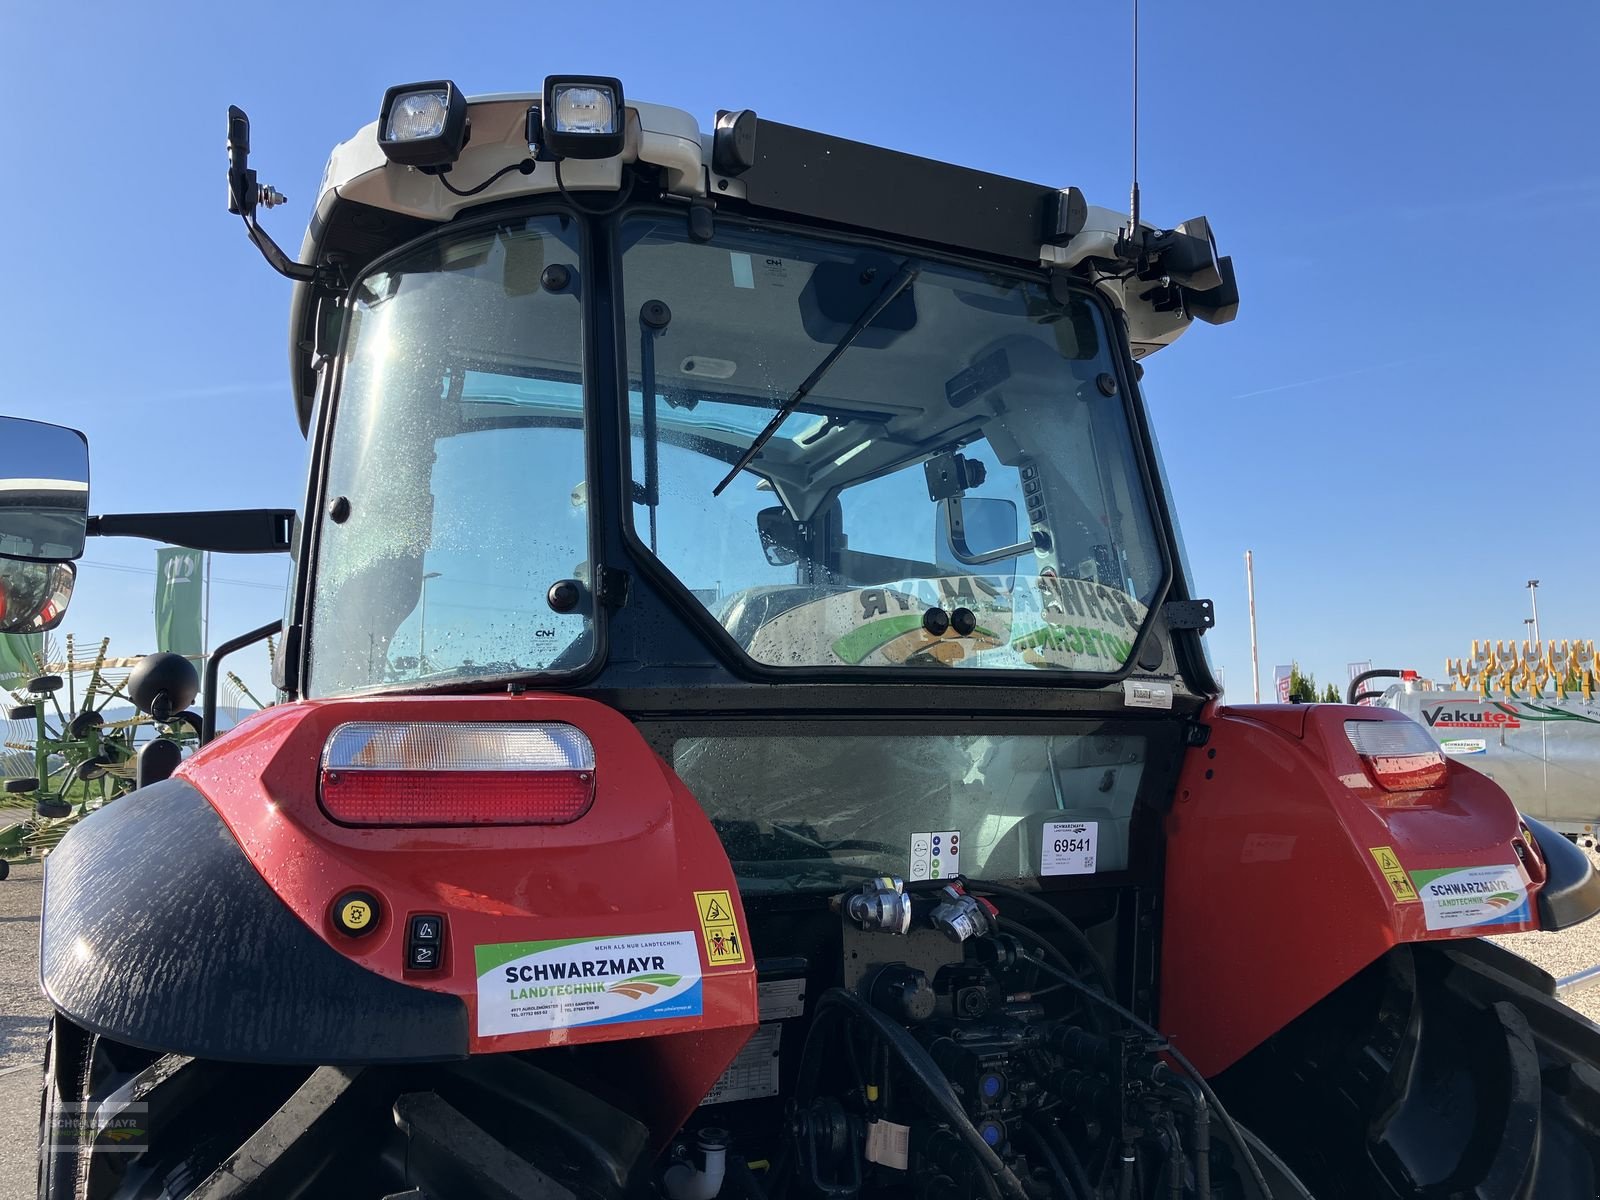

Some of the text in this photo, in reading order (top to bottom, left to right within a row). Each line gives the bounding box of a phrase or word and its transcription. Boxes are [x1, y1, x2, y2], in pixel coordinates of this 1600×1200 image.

[1054, 838, 1090, 852] 69541
[1430, 880, 1509, 896] SCHWARZMAYR
[1438, 897, 1484, 907] LANDTECHNIK
[505, 955, 665, 983] SCHWARZMAYR
[510, 981, 606, 1000] LANDTECHNIK
